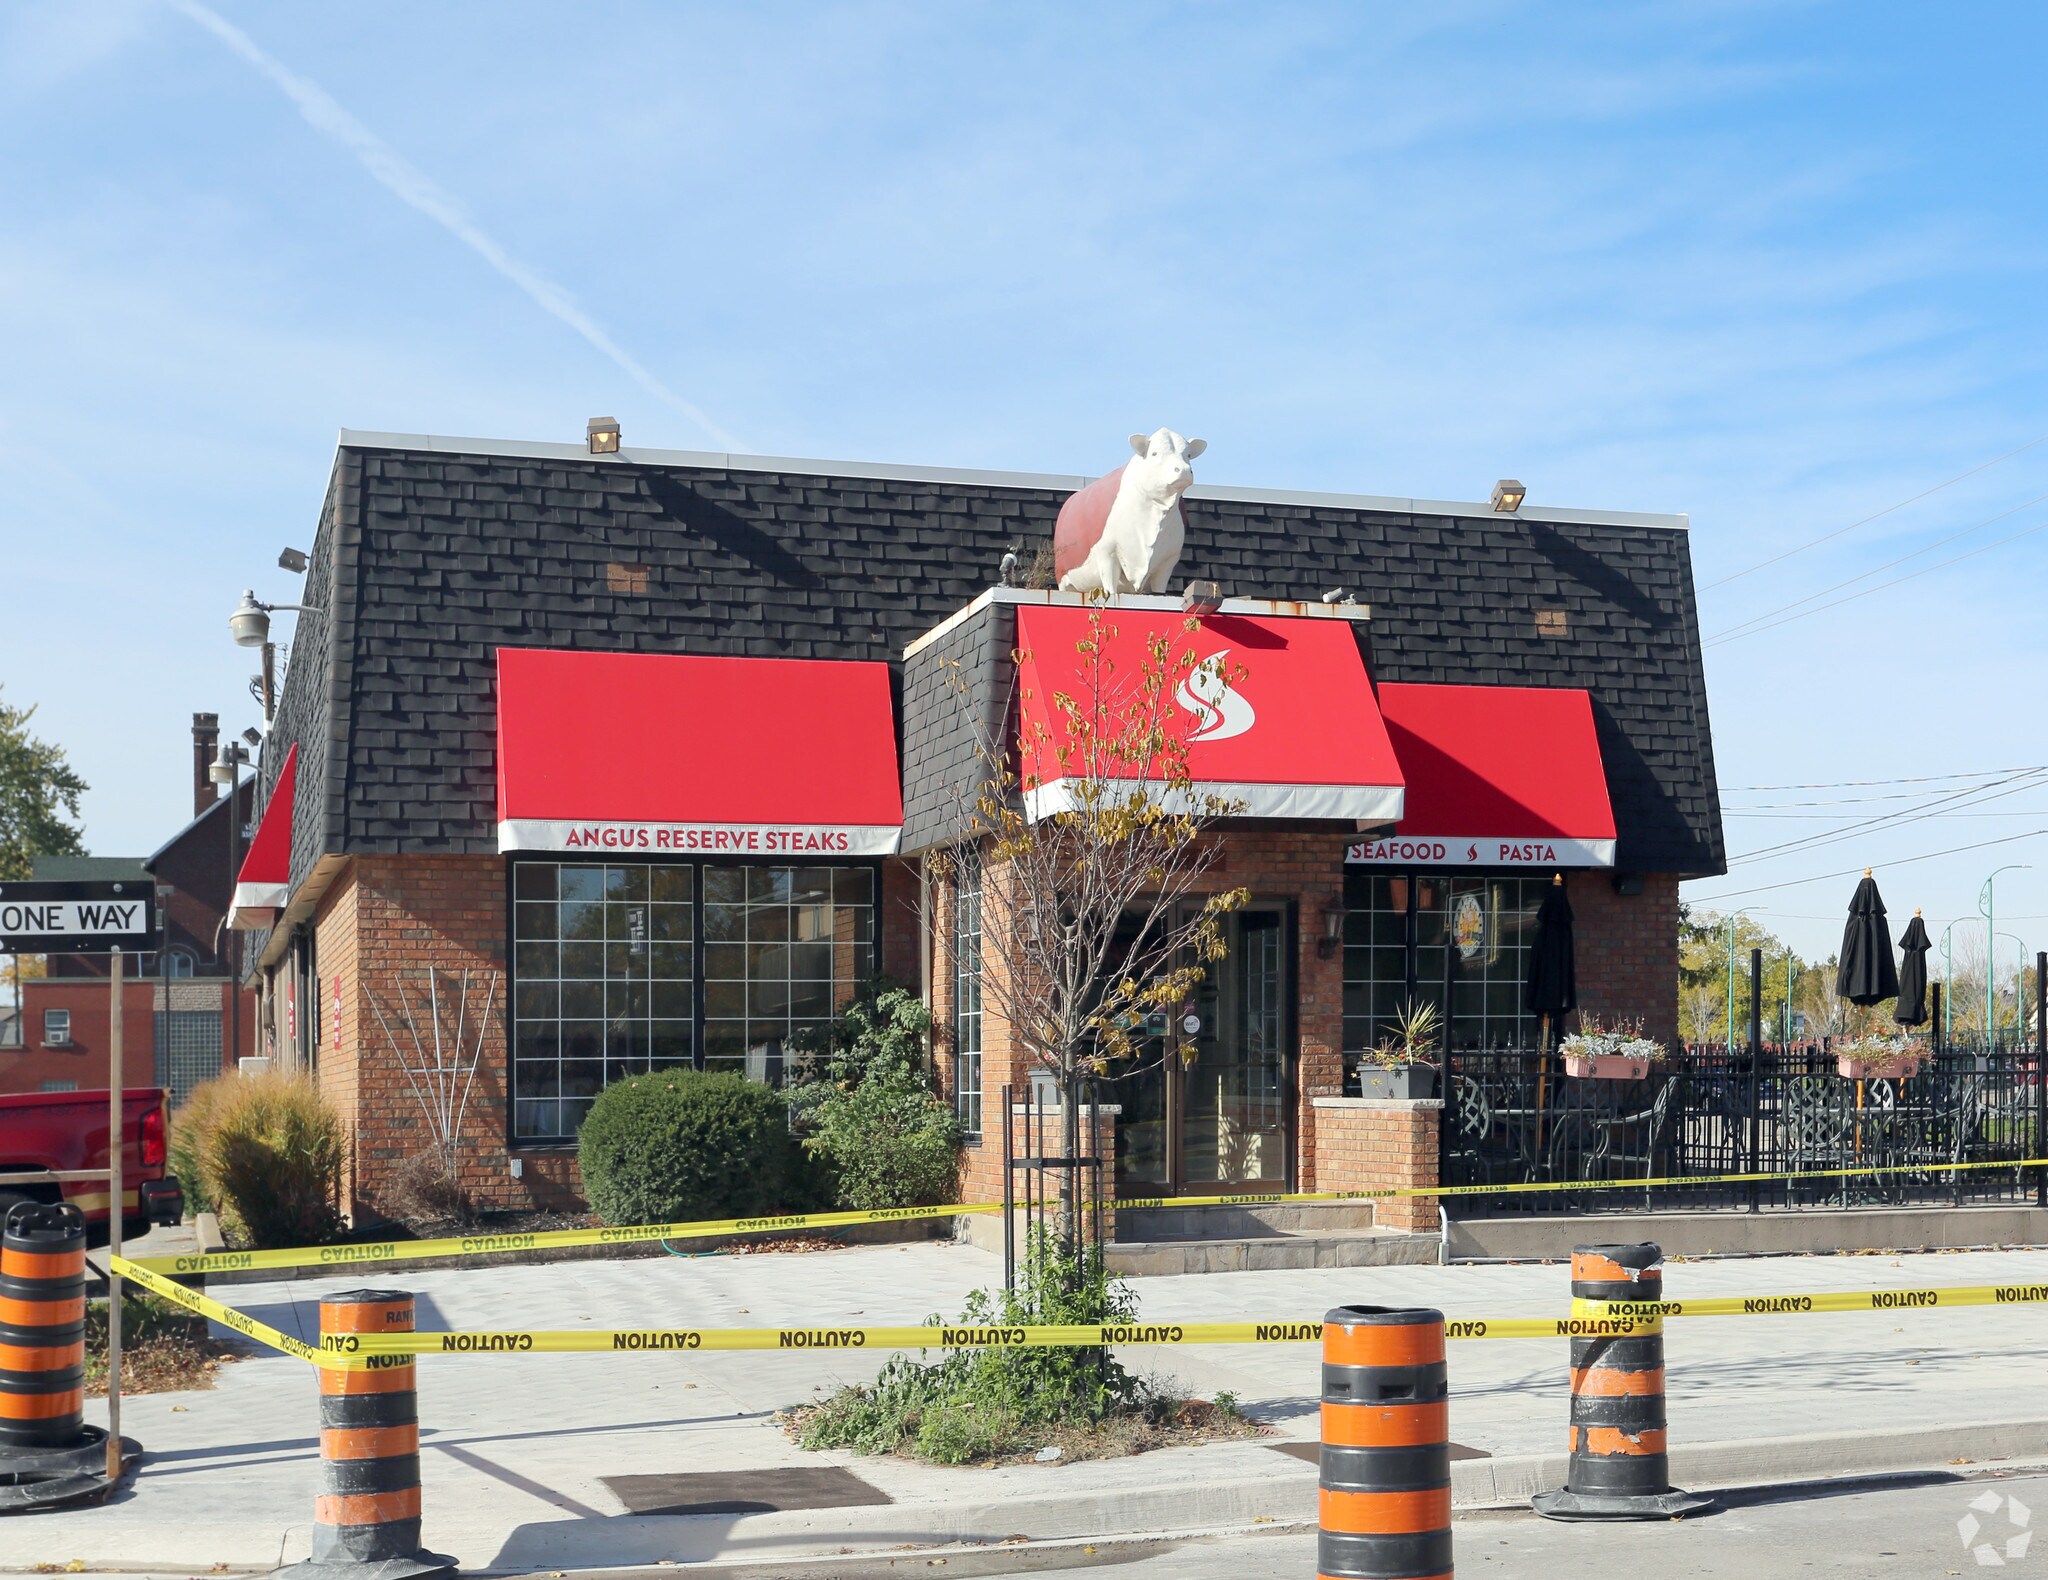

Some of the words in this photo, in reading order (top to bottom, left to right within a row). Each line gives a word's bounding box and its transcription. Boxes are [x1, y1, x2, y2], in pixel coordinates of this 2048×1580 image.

[566, 828, 649, 847] ANGUS
[657, 830, 759, 849] RESERVE
[766, 831, 849, 851] STEAKS
[1351, 842, 1446, 860] SEAFOOD
[1500, 844, 1557, 861] PASTA
[2, 906, 65, 931] ONE
[77, 905, 138, 930] WAY
[1872, 1291, 1938, 1308] CAUTION
[1995, 1286, 2048, 1302] AUTION
[1608, 1303, 1683, 1315] CAUTION
[1744, 1296, 1812, 1313] CAUTION
[223, 1308, 254, 1334] CAUTION
[1557, 1320, 1635, 1334] CAUTION
[613, 1332, 701, 1349] CAUTION
[779, 1330, 865, 1347] CAUTION
[942, 1328, 1026, 1345] CAUTION
[1101, 1326, 1183, 1342] CAUTION
[1256, 1324, 1323, 1341] AUTION
[280, 1334, 314, 1360] CAUTION
[442, 1334, 532, 1351] CAUTION
